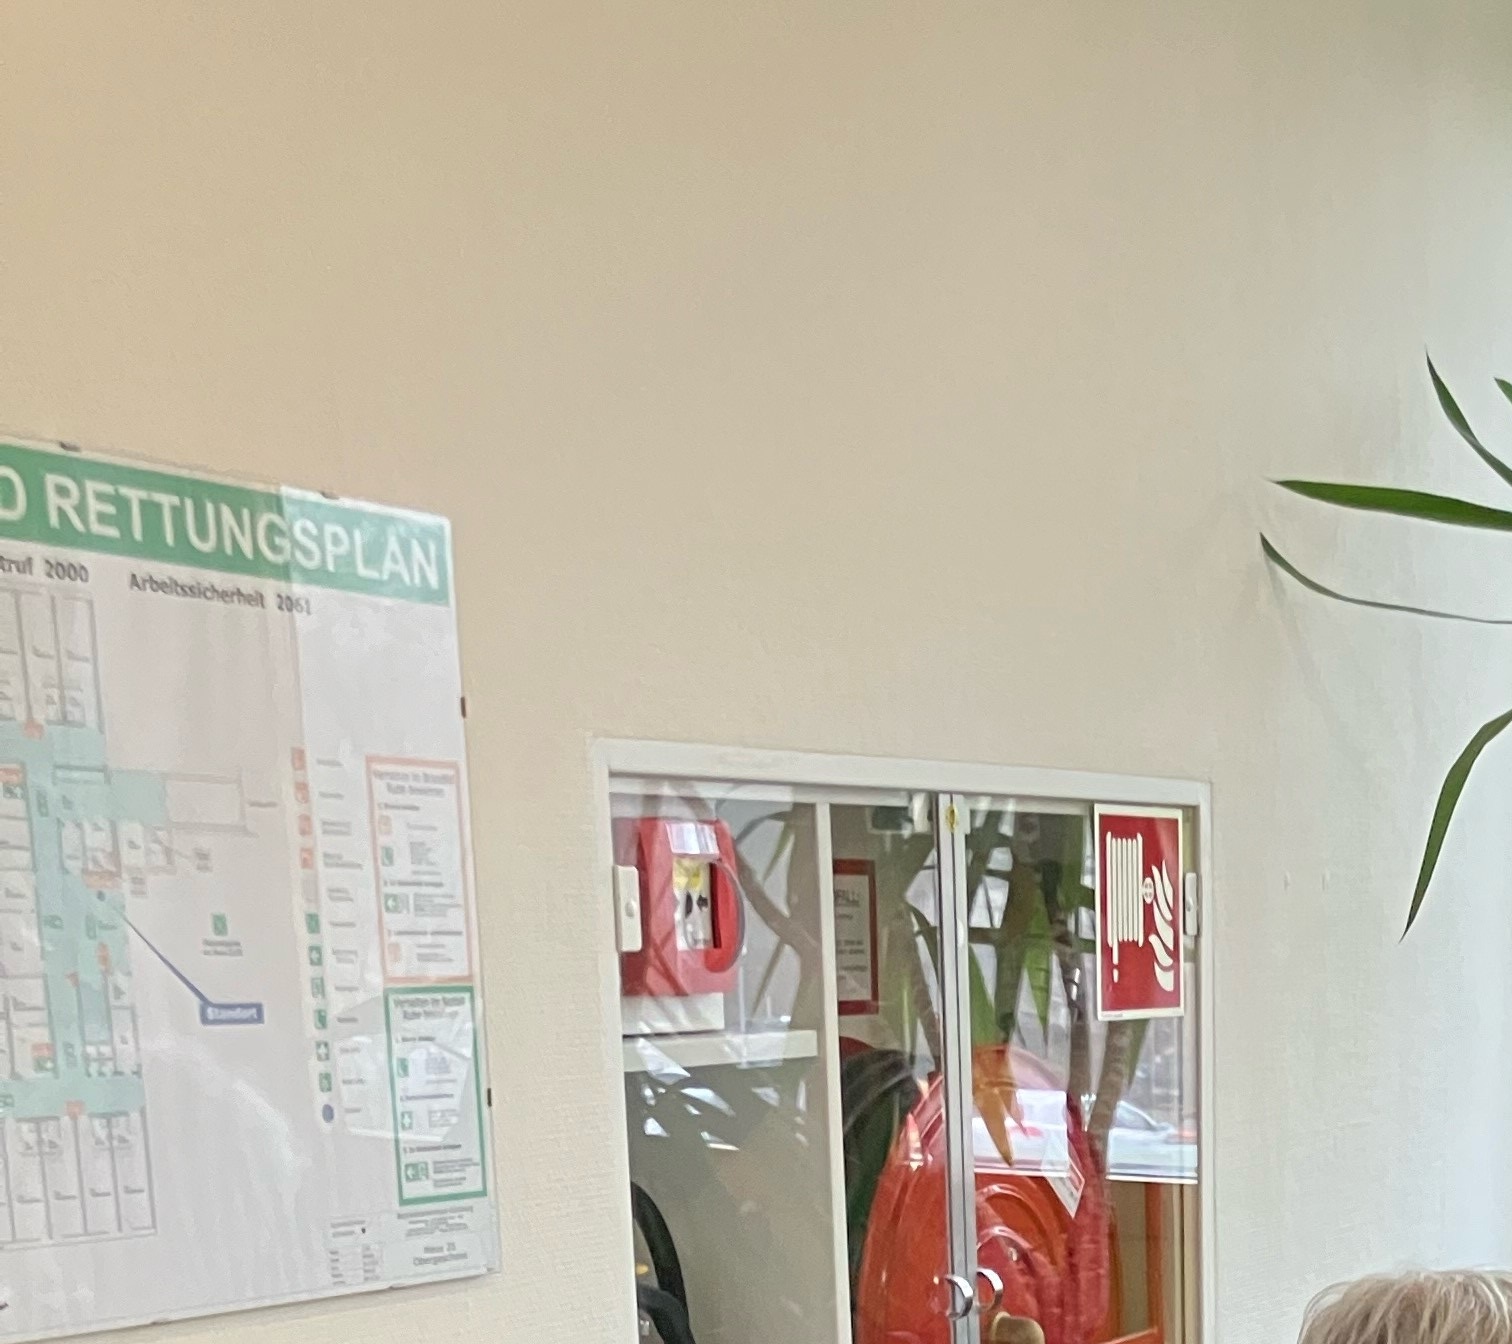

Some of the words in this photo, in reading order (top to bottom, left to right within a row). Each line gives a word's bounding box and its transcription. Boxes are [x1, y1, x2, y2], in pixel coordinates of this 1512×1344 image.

[44, 472, 440, 590] RETTUNGSPLAN
[45, 558, 90, 583] 2000
[130, 572, 266, 609] Arbeitssicherheit
